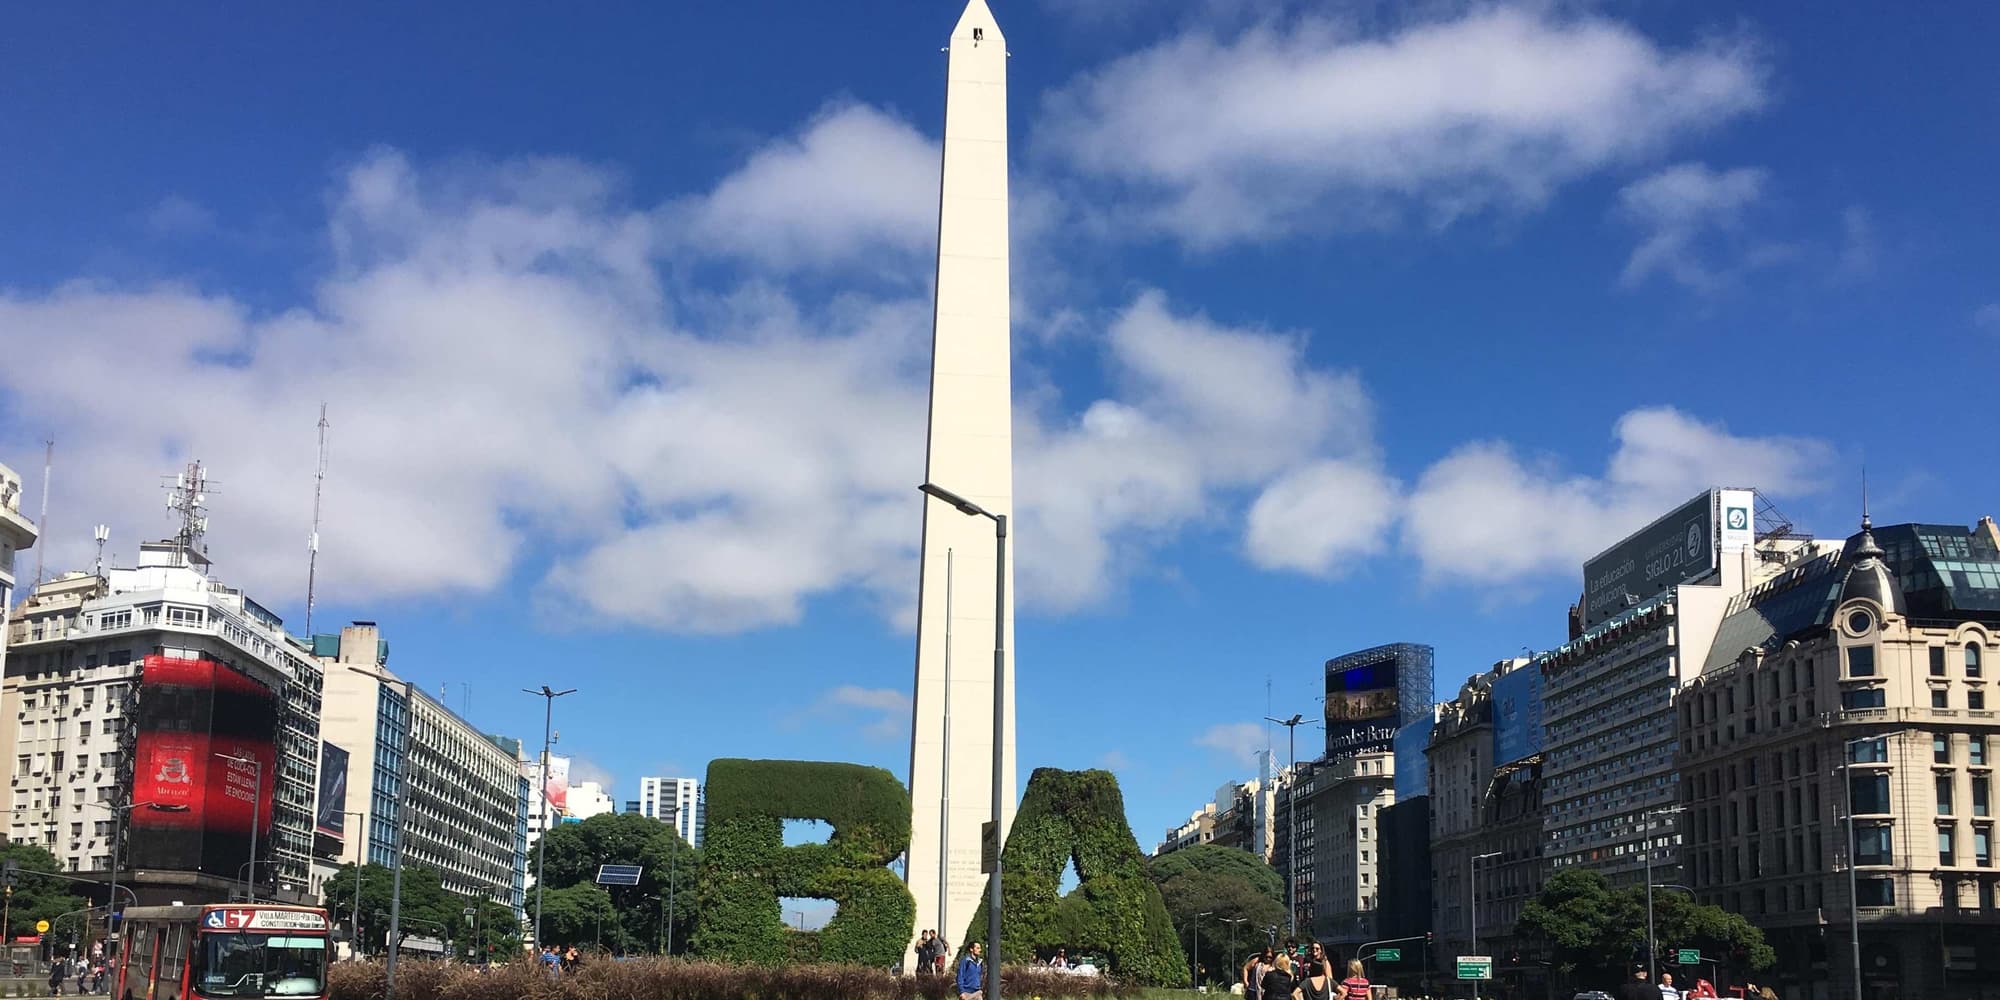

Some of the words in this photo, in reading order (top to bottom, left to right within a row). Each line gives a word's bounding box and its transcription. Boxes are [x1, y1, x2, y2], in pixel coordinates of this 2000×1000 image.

[1645, 554, 1672, 582] SIGLO
[1672, 546, 1684, 568] 21
[1590, 578, 1600, 595] La
[1599, 558, 1635, 587] educación
[1590, 584, 1627, 612] evoluciona
[234, 760, 257, 777] COCA-COL
[225, 784, 232, 797] DE
[224, 910, 257, 928] 67
